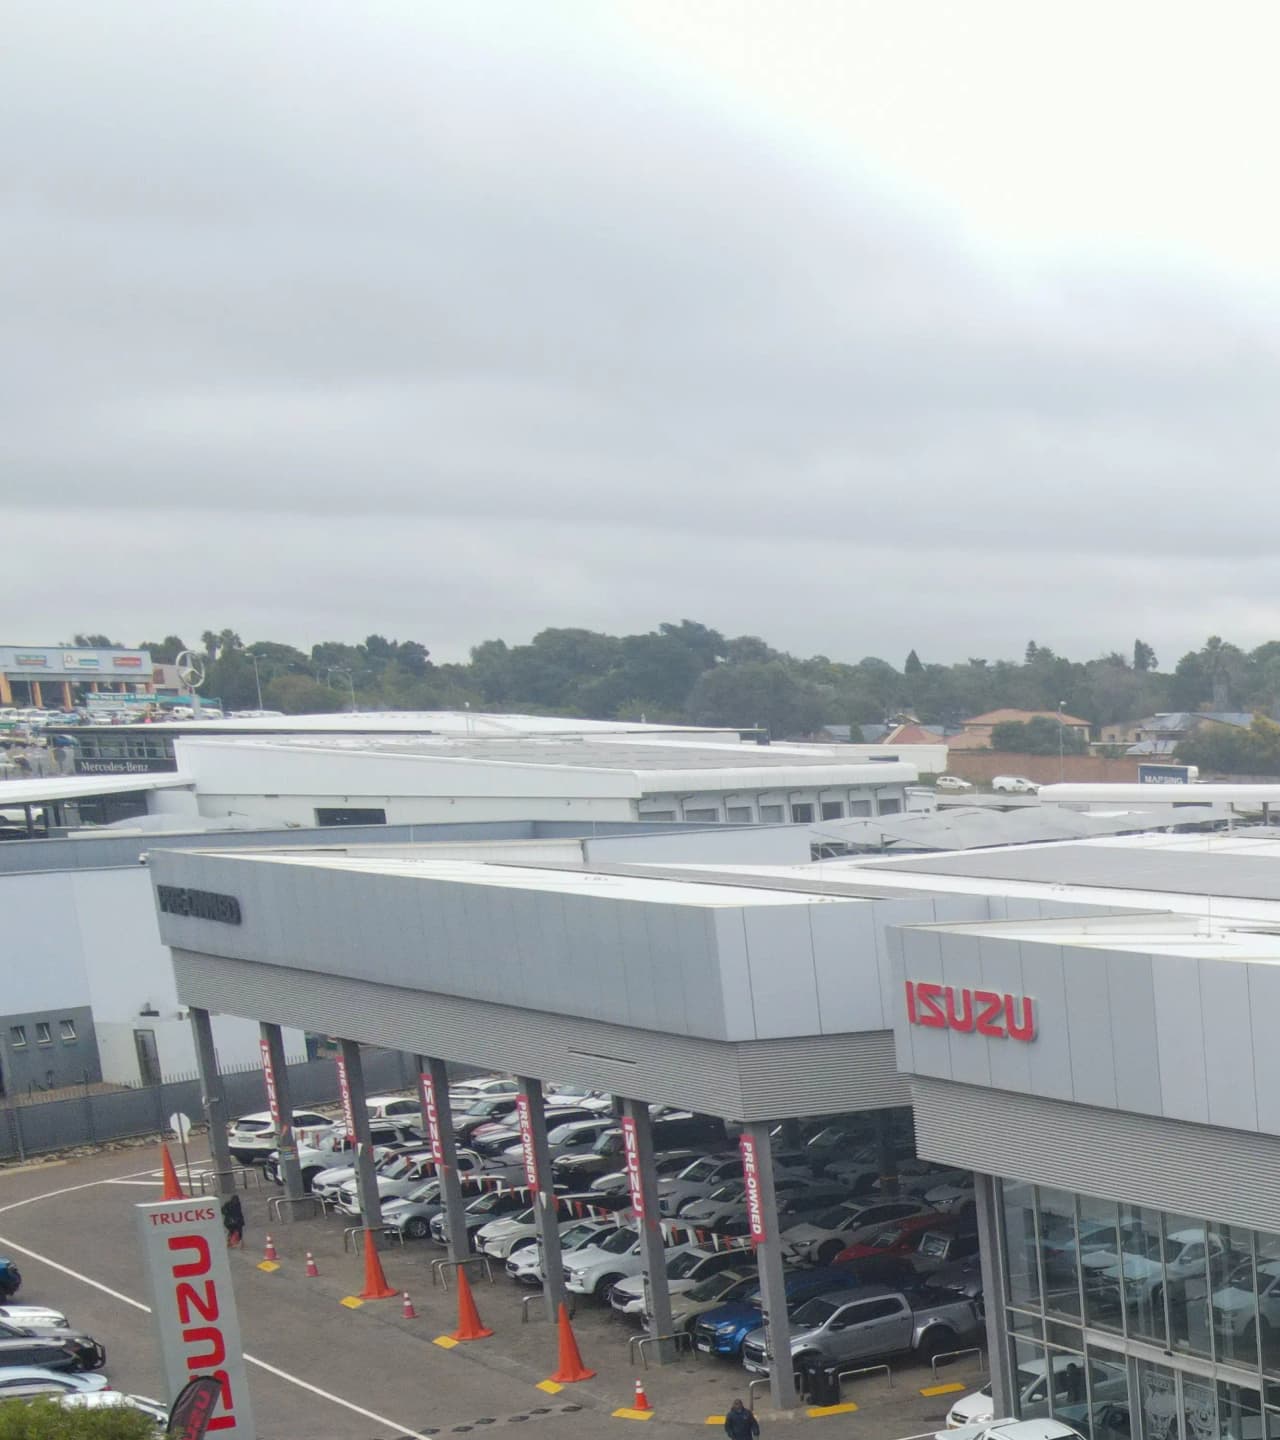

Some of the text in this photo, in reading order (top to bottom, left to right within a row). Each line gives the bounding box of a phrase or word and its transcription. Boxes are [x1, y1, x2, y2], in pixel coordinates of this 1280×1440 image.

[81, 761, 149, 772] Mercedes-Benz
[905, 979, 1037, 1042] ISUZU
[422, 1079, 443, 1159] ISUZU
[517, 1100, 536, 1185] PRE-OWNED
[623, 1123, 644, 1212] ISUZU
[743, 1141, 763, 1236] PRE-OWNED
[150, 1207, 216, 1227] TRUCKS
